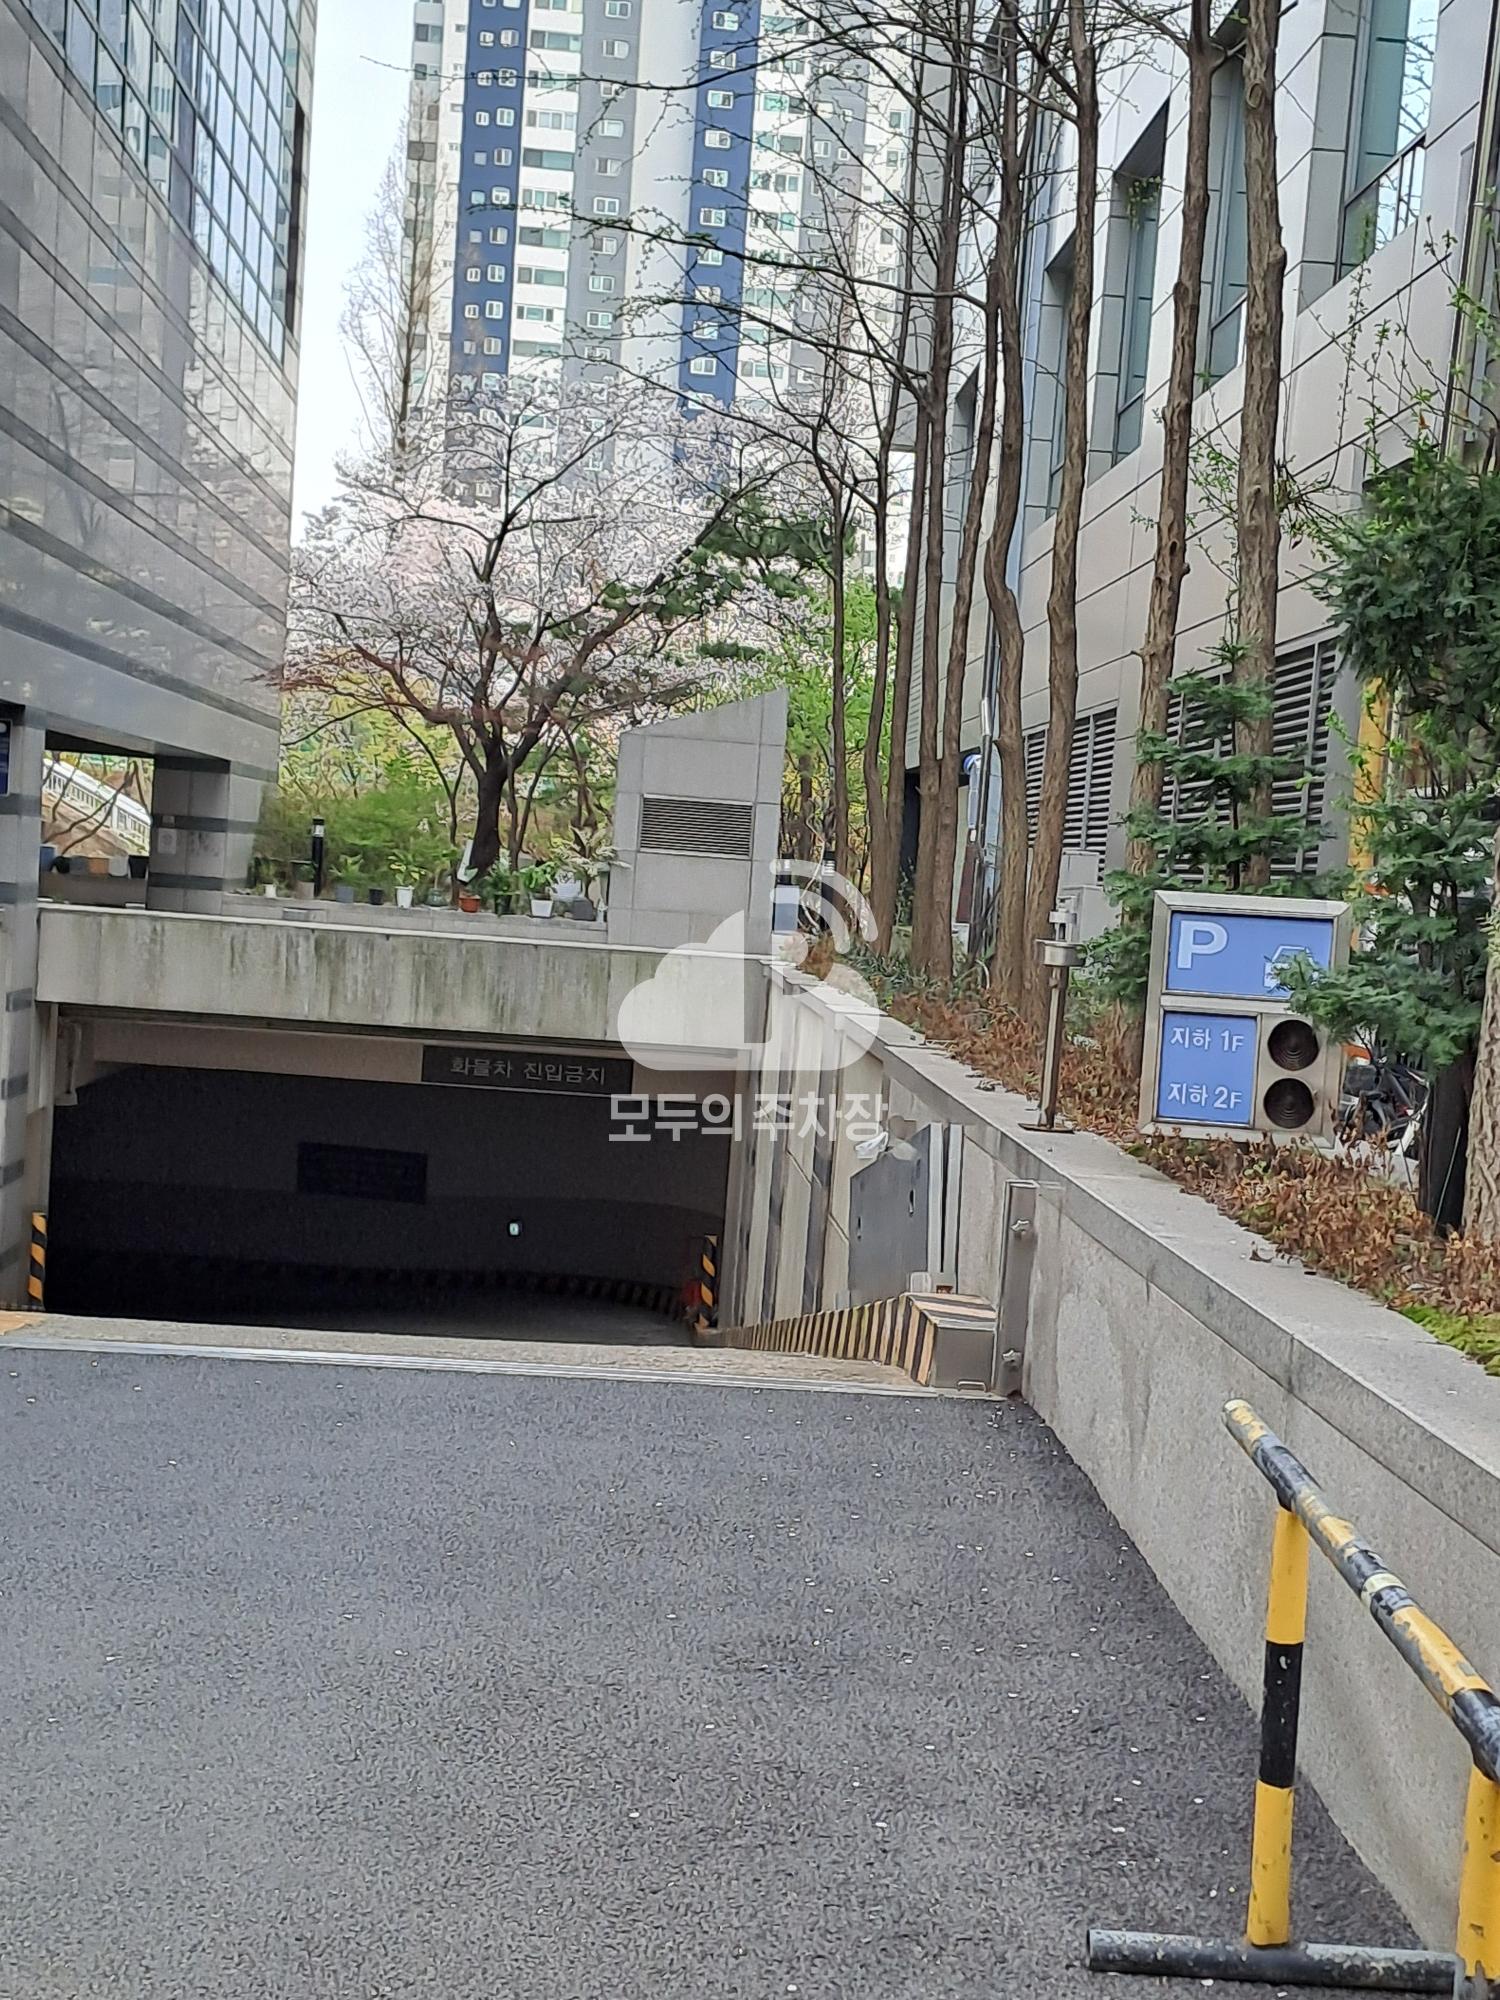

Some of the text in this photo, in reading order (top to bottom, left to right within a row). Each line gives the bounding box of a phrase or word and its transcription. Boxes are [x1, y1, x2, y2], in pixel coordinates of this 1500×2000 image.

[1177, 920, 1228, 969] P
[1170, 1027, 1245, 1053] 지하 1F
[524, 1061, 606, 1086] 진입금지
[1167, 1083, 1243, 1110] 지하 2F
